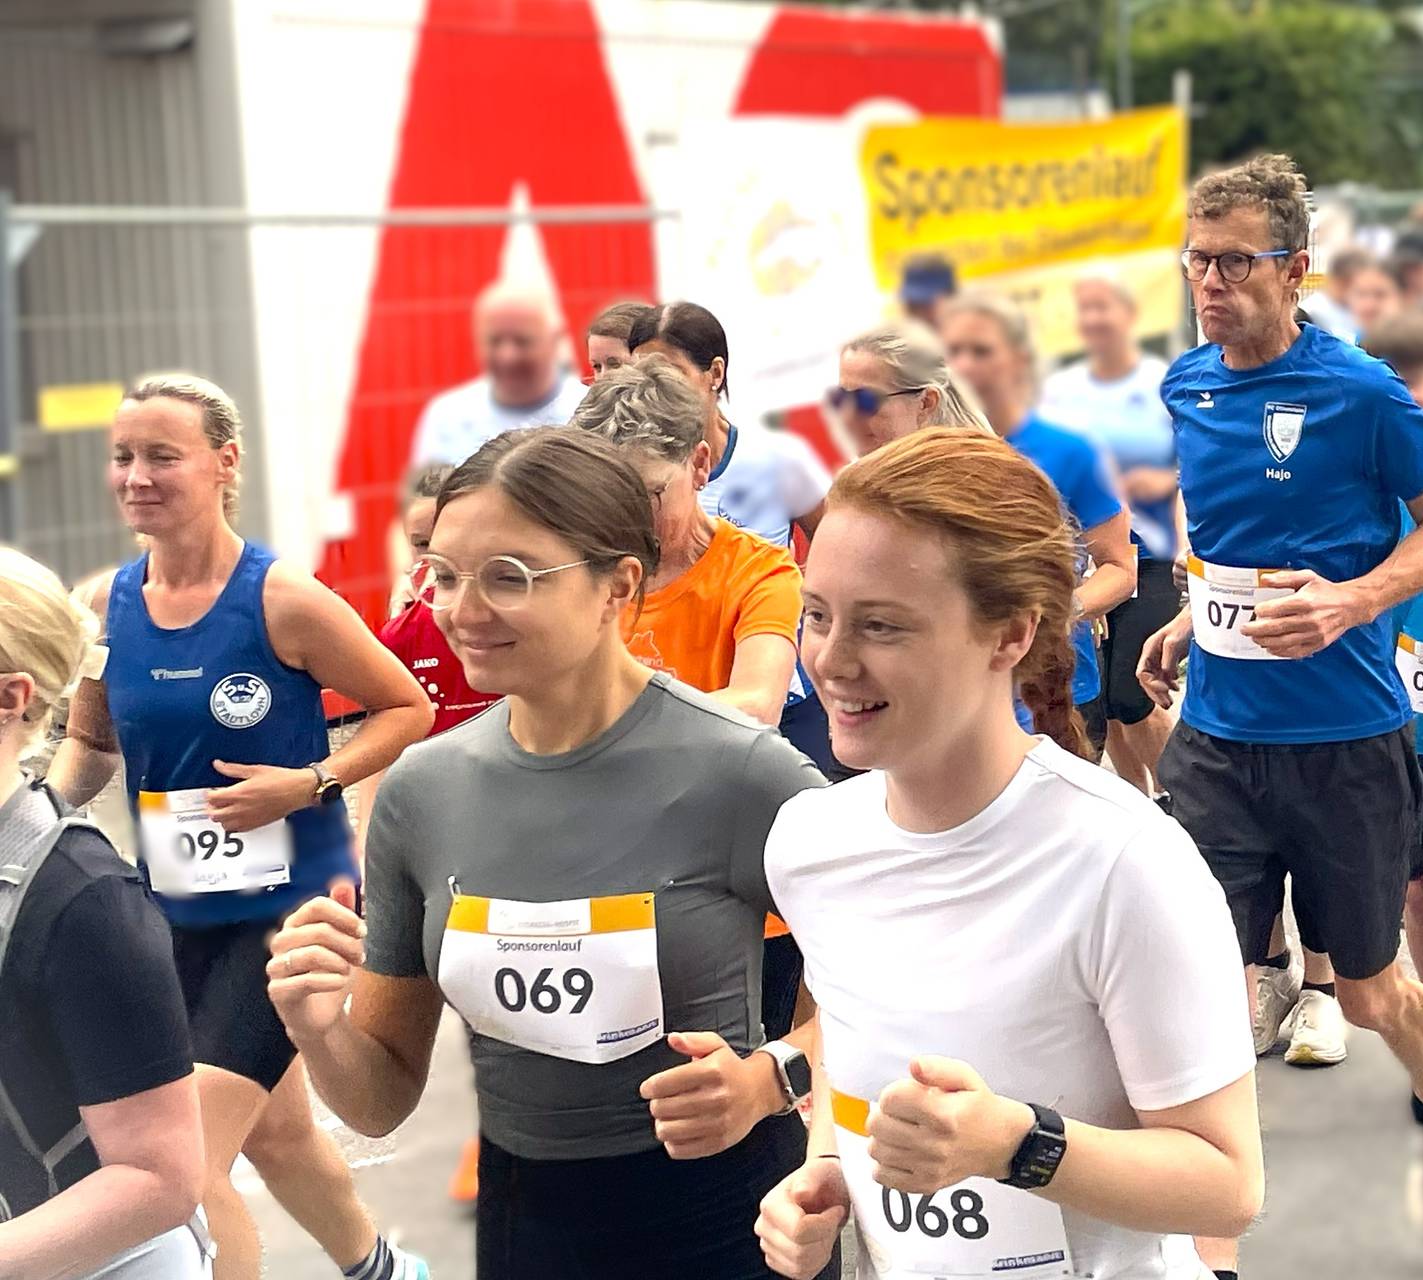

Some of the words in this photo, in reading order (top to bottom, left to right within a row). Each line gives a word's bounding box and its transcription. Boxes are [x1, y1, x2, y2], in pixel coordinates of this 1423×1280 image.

[873, 139, 1164, 236] Sponsorenlauf
[1266, 468, 1292, 481] Hajo
[1208, 600, 1257, 629] 077
[413, 658, 439, 669] JAKO
[215, 696, 266, 724] STADTLOHN
[172, 829, 244, 861] 095
[496, 938, 583, 953] Sponsorenlauf
[494, 967, 594, 1015] 069
[882, 1185, 989, 1240] 068
